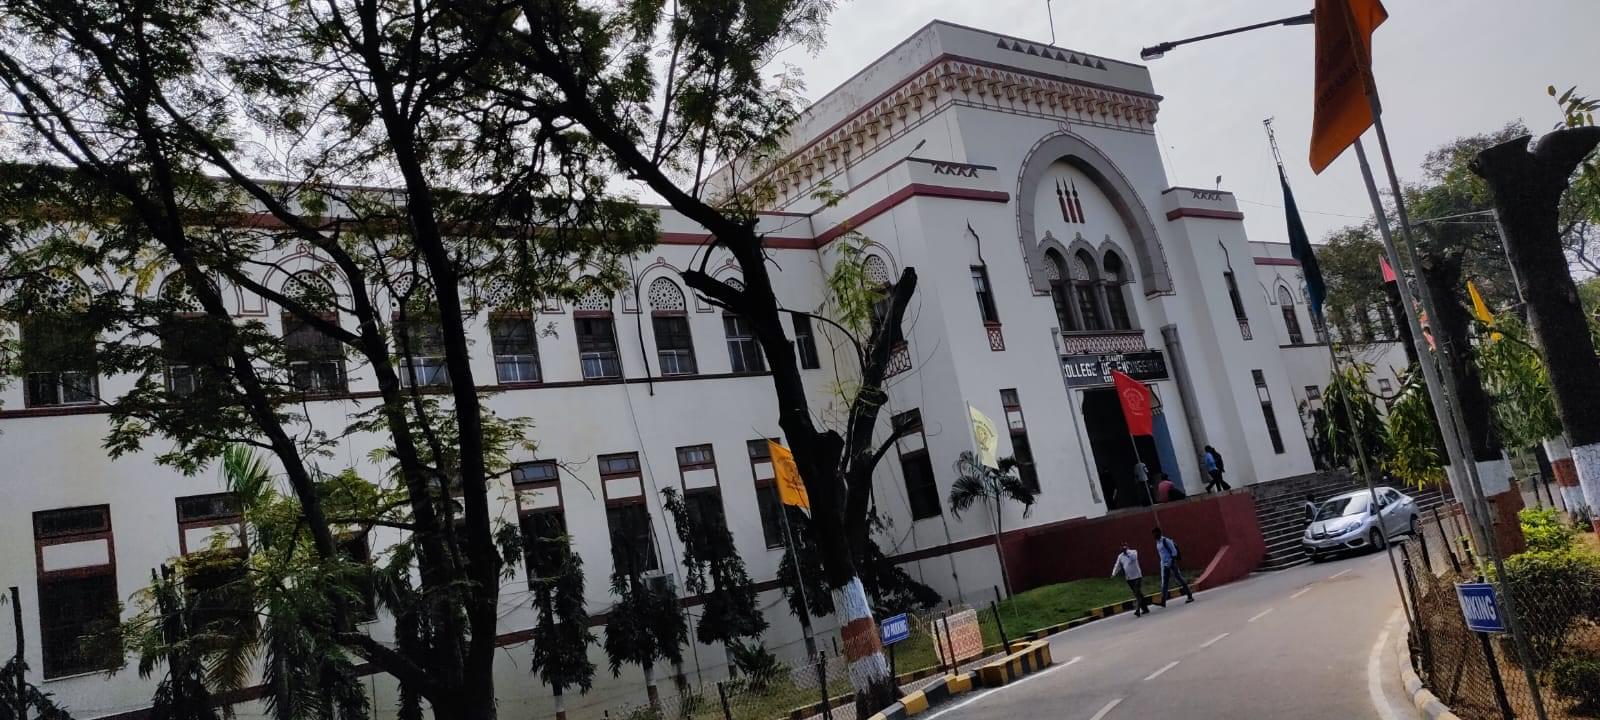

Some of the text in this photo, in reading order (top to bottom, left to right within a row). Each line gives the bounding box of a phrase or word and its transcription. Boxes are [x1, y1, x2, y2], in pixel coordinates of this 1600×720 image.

[1101, 361, 1112, 375] OF
[883, 619, 906, 639] NO PARKING
